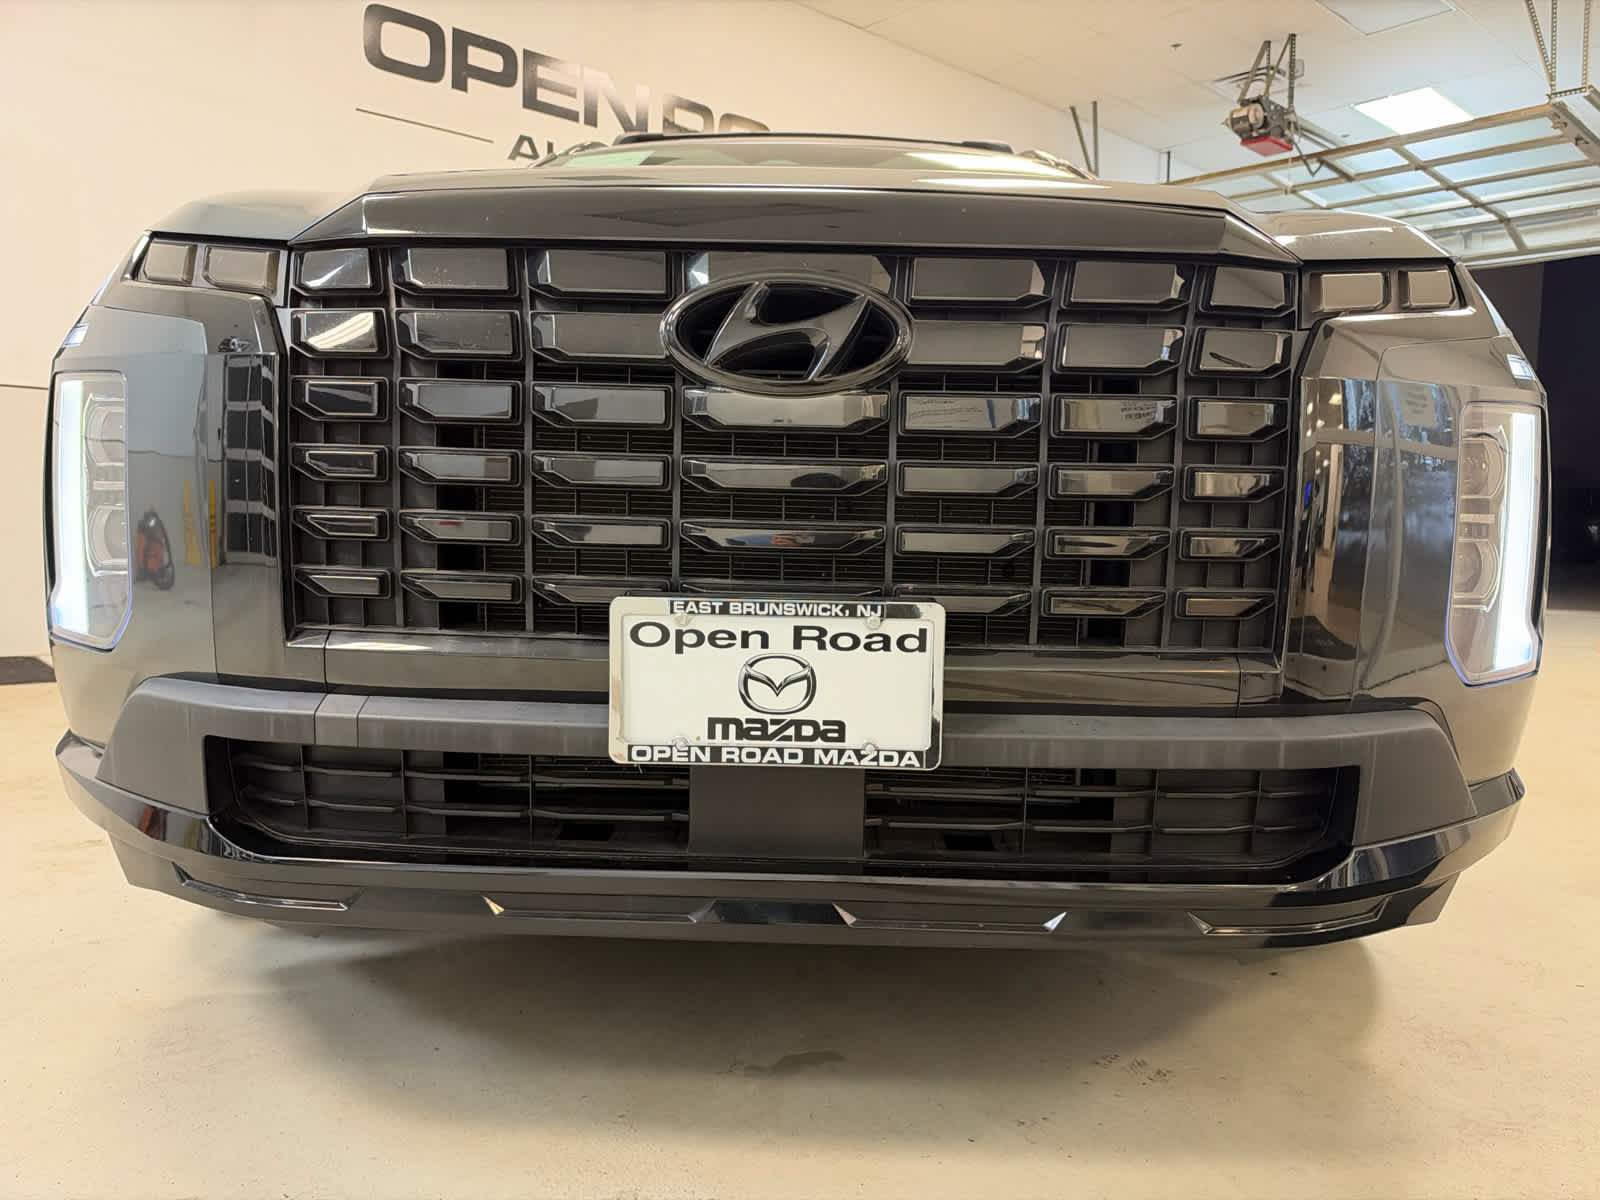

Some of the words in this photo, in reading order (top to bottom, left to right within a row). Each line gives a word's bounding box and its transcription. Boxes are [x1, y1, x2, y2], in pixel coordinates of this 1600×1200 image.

[363, 3, 649, 133] OPEN
[672, 601, 722, 616] EAST
[729, 602, 850, 618] BRUNSWICK,
[857, 604, 882, 618] NJ
[629, 621, 770, 655] Open
[793, 625, 928, 653] Road
[631, 746, 711, 763] OPEN
[721, 747, 804, 765] ROAD
[814, 749, 920, 768] MAZDA
